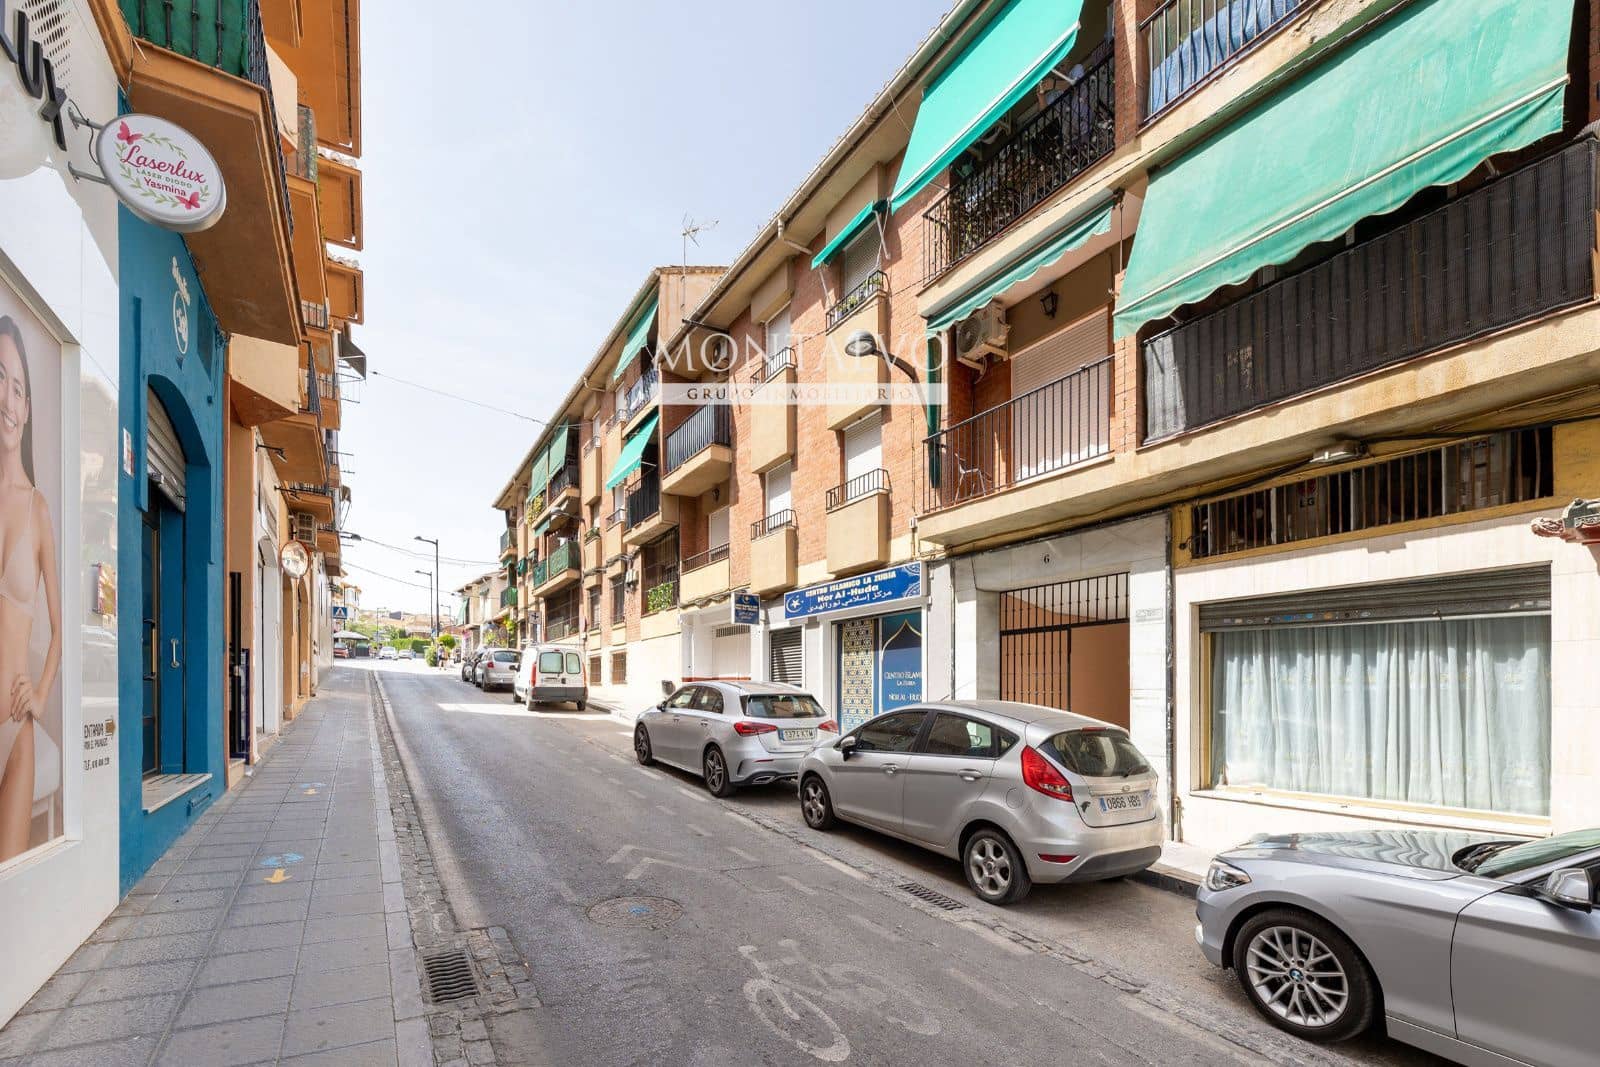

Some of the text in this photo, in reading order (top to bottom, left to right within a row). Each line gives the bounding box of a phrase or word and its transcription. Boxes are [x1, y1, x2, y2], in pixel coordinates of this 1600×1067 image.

[0, 0, 67, 152] ux
[120, 145, 207, 184] Laserlux
[136, 168, 163, 180] LASER
[143, 176, 187, 197] Yasmina
[1043, 554, 1050, 564] 6
[805, 586, 828, 598] CENTRO
[863, 576, 872, 585] LA
[874, 570, 897, 582] ZUBIA
[817, 594, 833, 603] Nor
